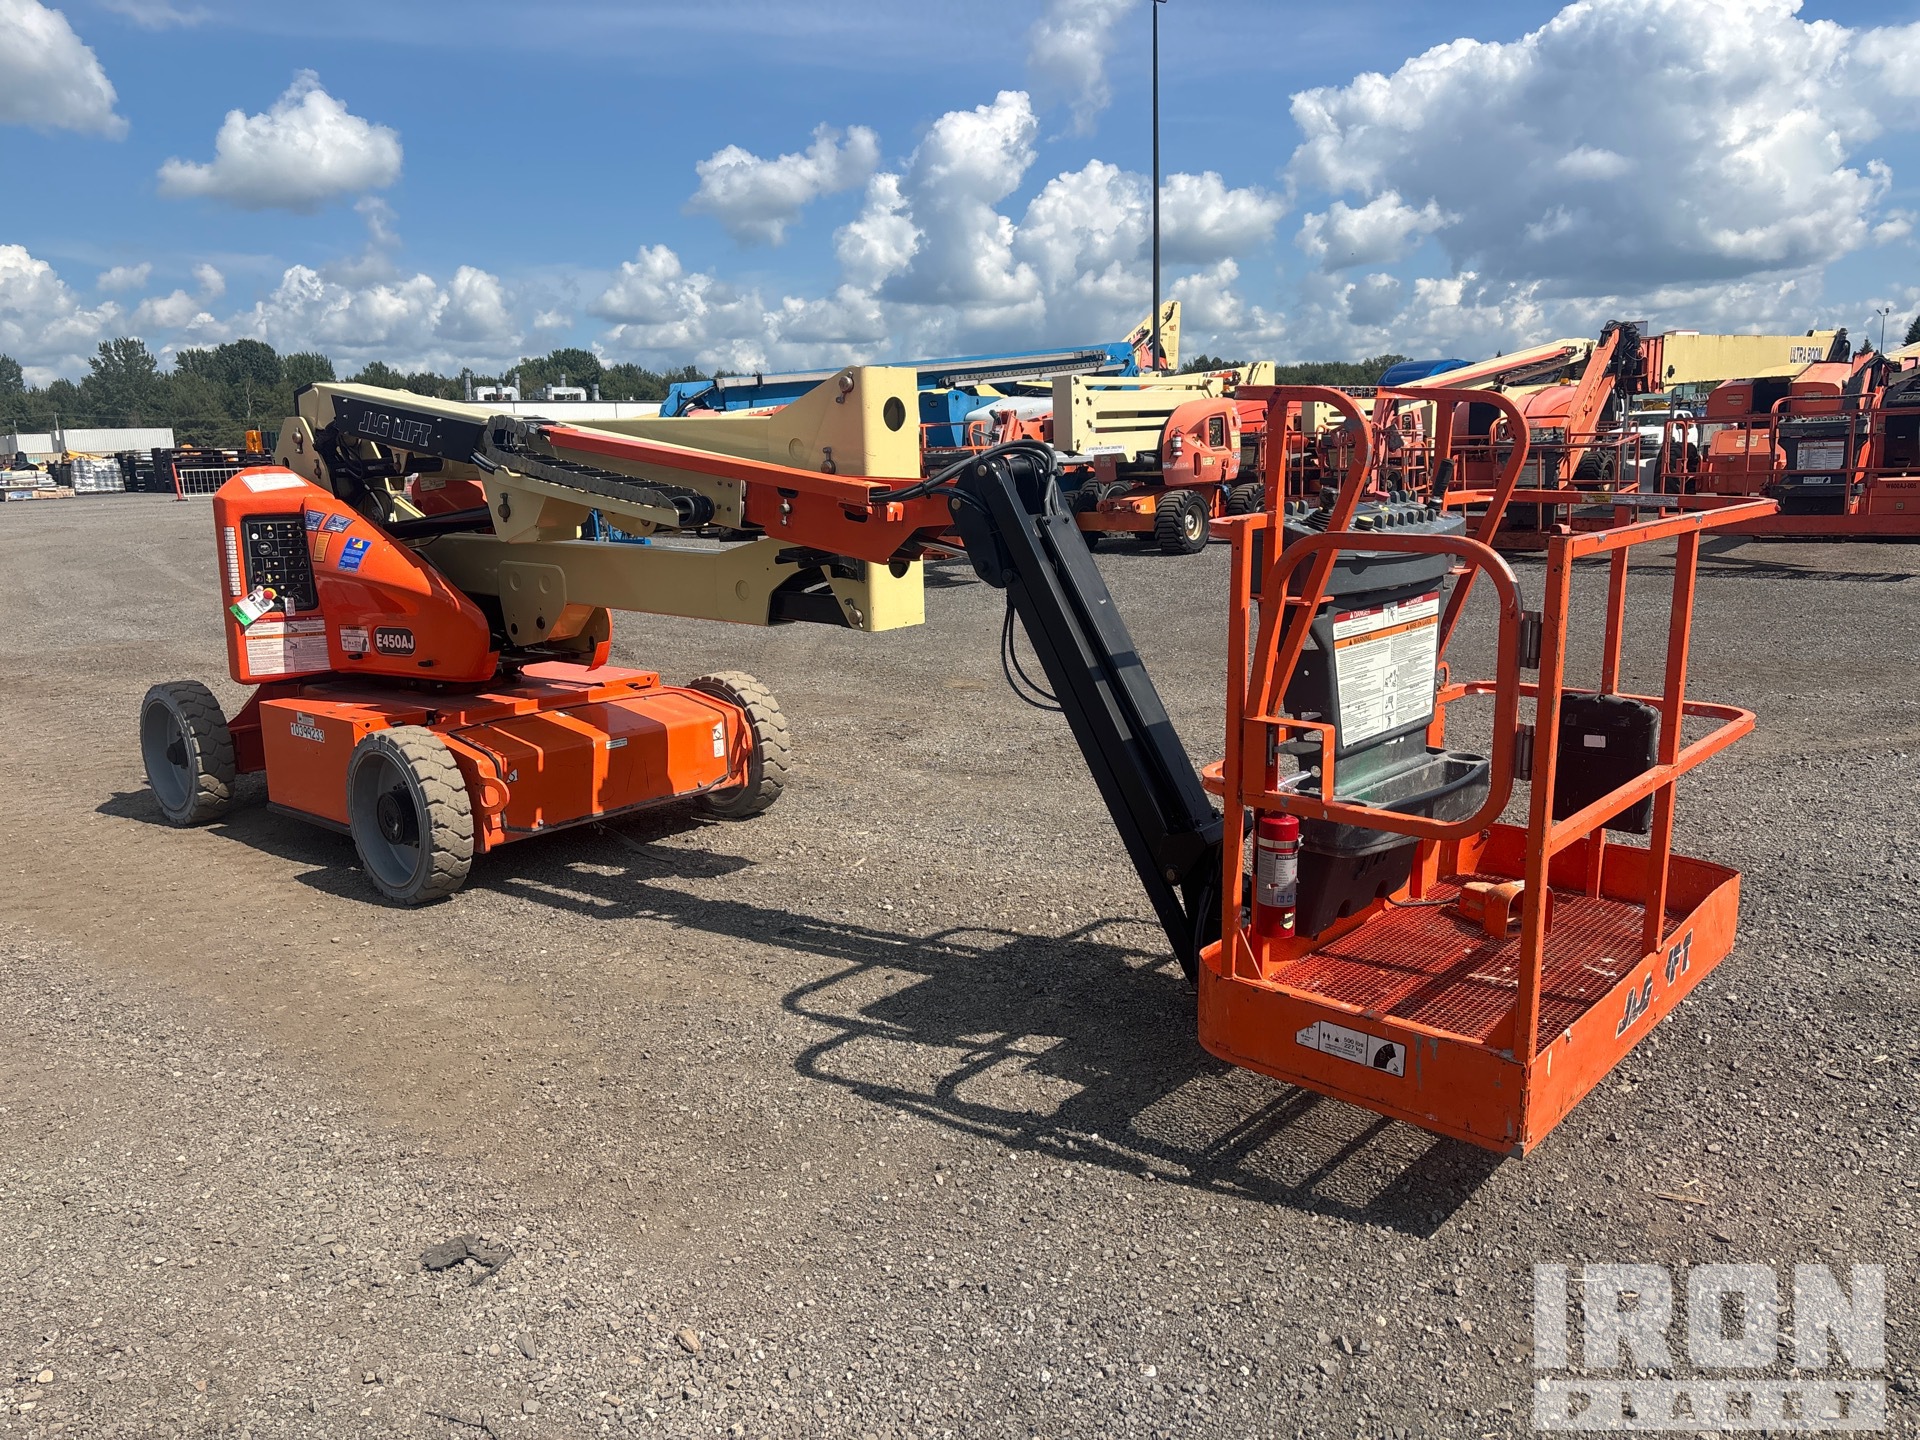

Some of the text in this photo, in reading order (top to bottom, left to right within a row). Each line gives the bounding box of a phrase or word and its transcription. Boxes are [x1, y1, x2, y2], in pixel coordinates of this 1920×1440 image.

[1790, 346, 1823, 363] ULTRA BOOM
[358, 411, 432, 446] JLG LIFT
[375, 633, 415, 650] E450AJ
[1353, 634, 1372, 645] WARNING
[1343, 1037, 1364, 1048] 500 lbs
[1355, 1046, 1363, 1054] kg
